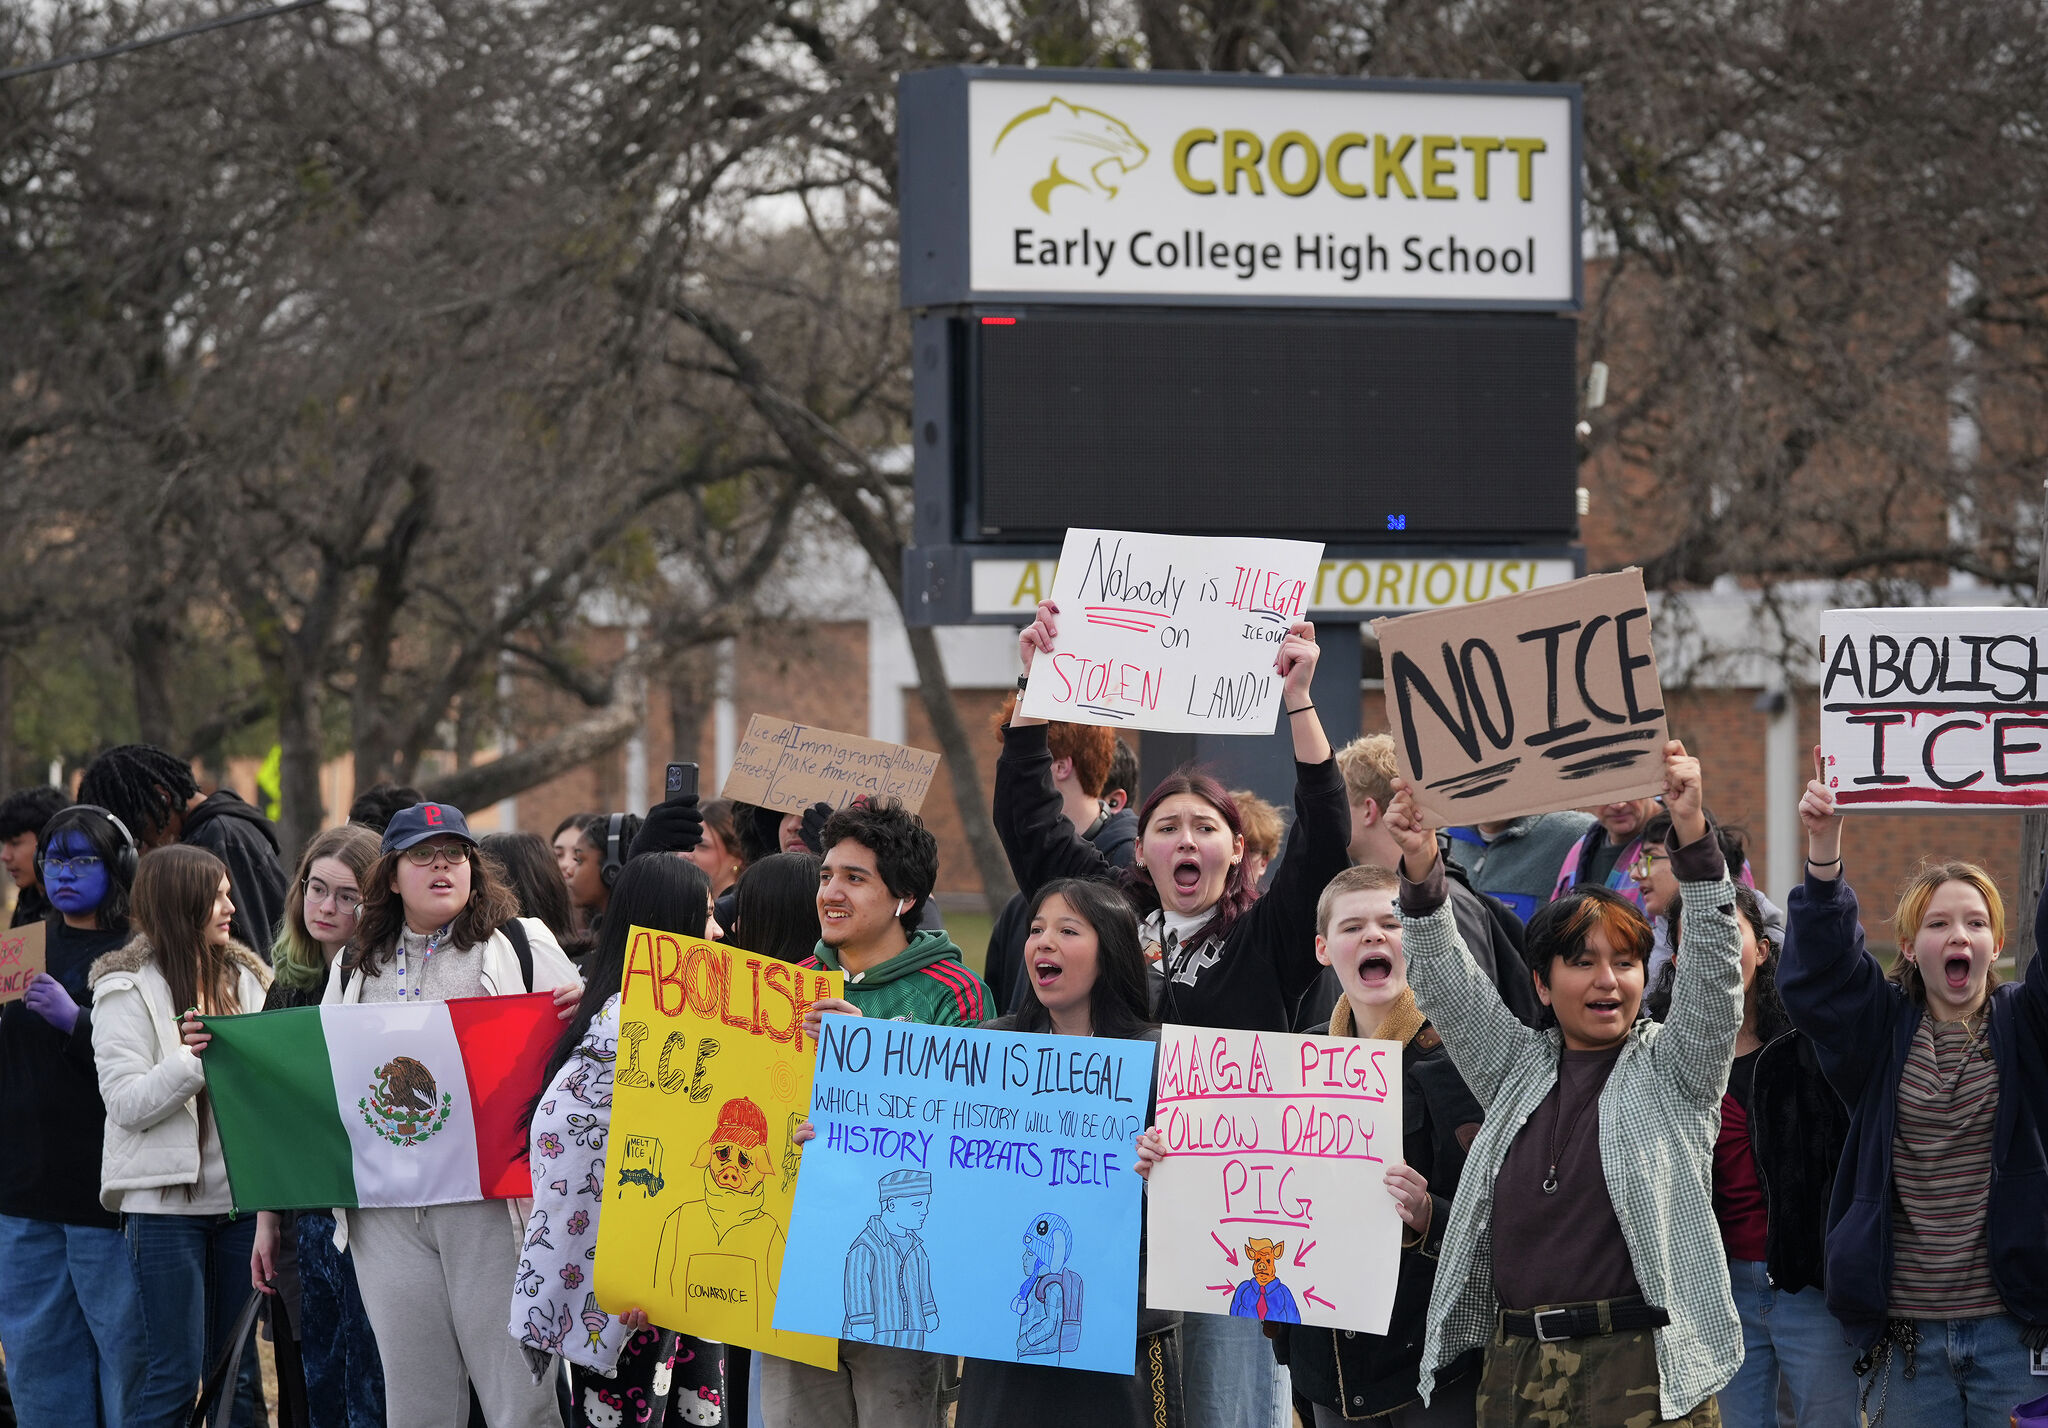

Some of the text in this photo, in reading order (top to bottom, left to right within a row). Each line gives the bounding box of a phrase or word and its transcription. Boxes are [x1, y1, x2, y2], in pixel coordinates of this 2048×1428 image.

[1173, 129, 1546, 201] CROCKETT
[1014, 228, 1534, 280] Early College High School
[1077, 537, 1185, 615] Nobody
[1200, 573, 1219, 603] is
[1161, 625, 1190, 648] on
[1242, 624, 1263, 640] ICE
[1052, 653, 1270, 722] STOLEN LAND!!
[1391, 607, 1665, 781] NO ICE
[740, 742, 758, 757] our
[771, 728, 790, 746] off
[784, 725, 892, 769] Immigrants
[890, 748, 936, 776] Abolish
[1846, 714, 2048, 789] ICE
[819, 761, 877, 791] America
[820, 1023, 1133, 1103] NO HUMAN IS ILLEGAL
[1158, 1033, 1388, 1099] MAGA PIGS
[814, 1083, 1141, 1145] WHICH SIDE OF HISTORY WILL YOU BE ON?
[1281, 1104, 1375, 1157] DADDY
[630, 1138, 650, 1148] MELT
[631, 1147, 645, 1158] ICE
[827, 1122, 1121, 1188] HISTORY REPEATS ITSELF
[1223, 1159, 1313, 1220] PIG
